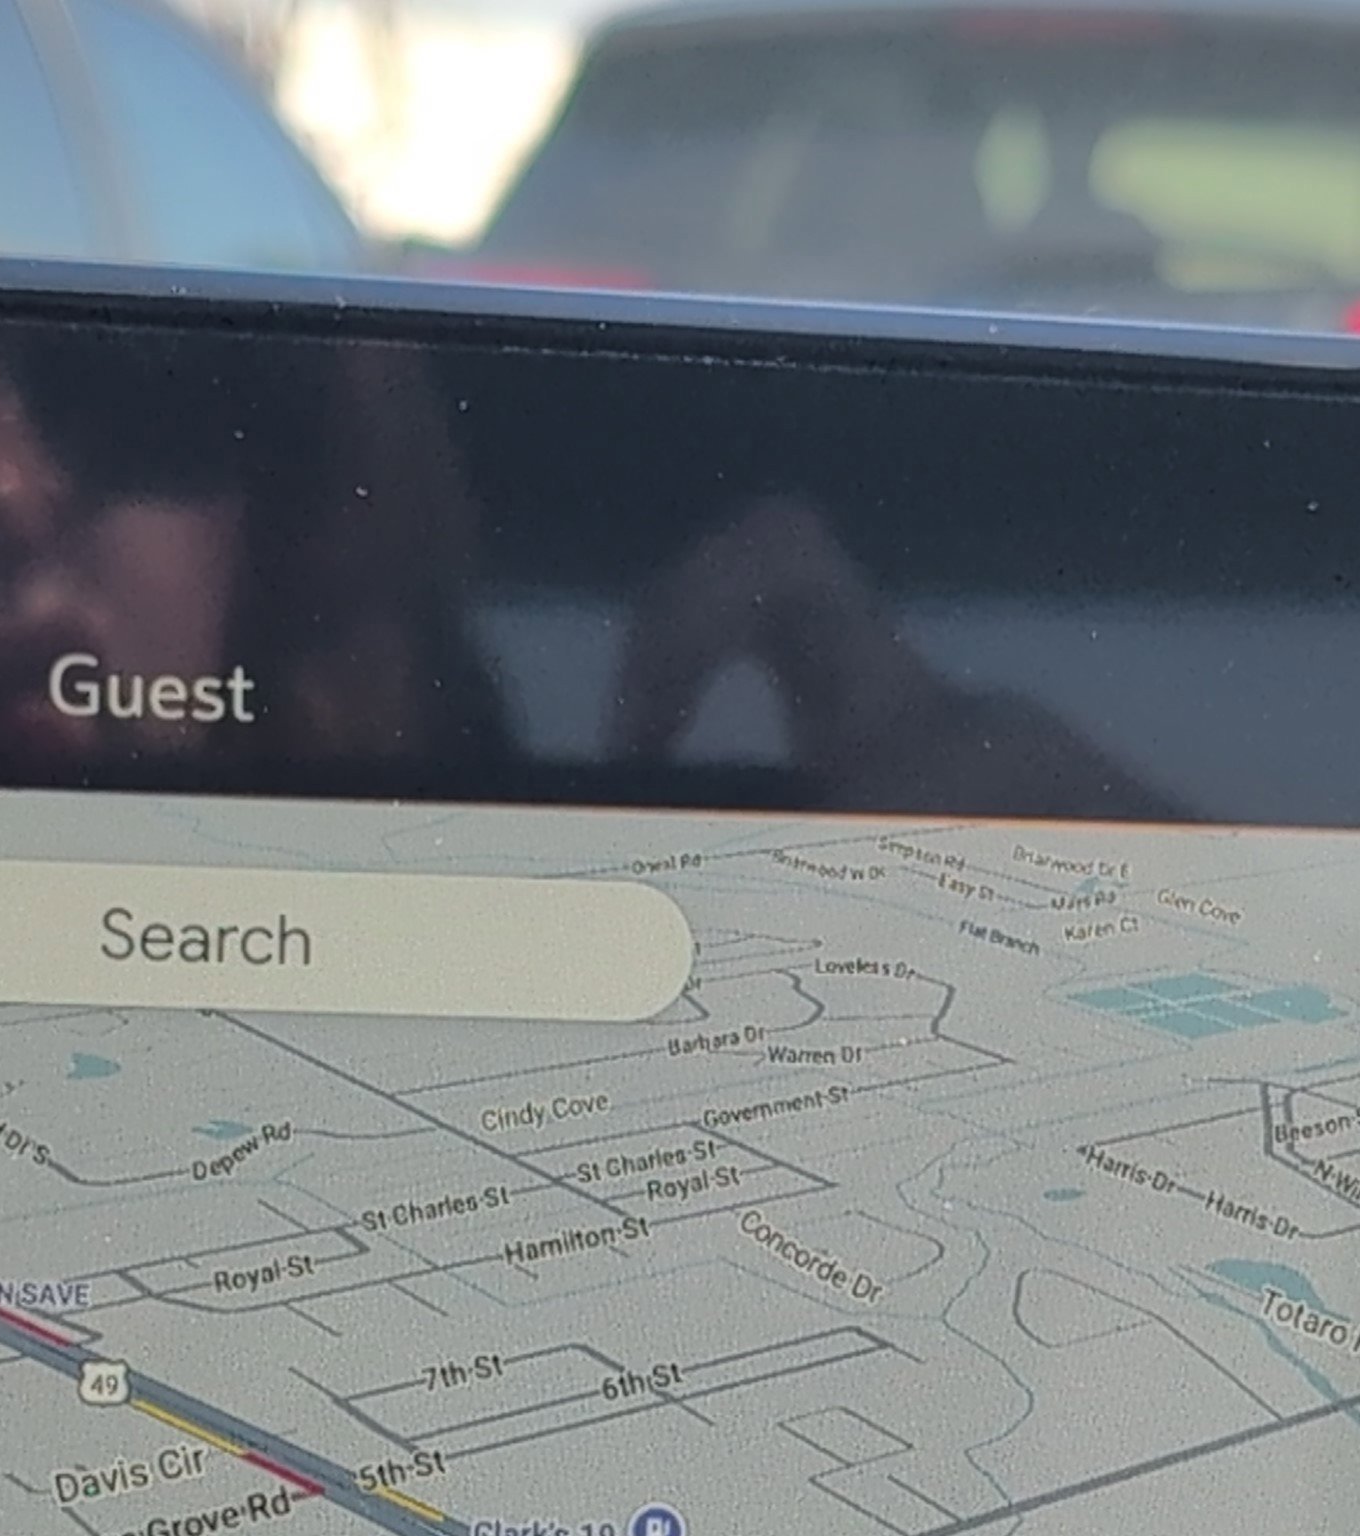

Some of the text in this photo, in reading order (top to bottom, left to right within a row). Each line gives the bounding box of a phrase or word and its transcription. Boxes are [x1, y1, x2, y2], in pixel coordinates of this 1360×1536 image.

[49, 653, 255, 722] Guest
[1198, 898, 1242, 925] Cove
[100, 906, 312, 966] Search
[958, 920, 1040, 955] Flat Branch
[1064, 923, 1115, 942] Karen
[767, 1045, 862, 1065] Warren Dr
[481, 1092, 610, 1132] Cindy Cove
[701, 1085, 849, 1128] Government St
[4, 1128, 35, 1156] Dr
[33, 1145, 51, 1167] S
[192, 1121, 292, 1182] Depew Rd
[576, 1138, 718, 1184] St Charles St
[647, 1164, 742, 1204] Royal St
[1085, 1146, 1179, 1195] Harris Dr
[1312, 1158, 1333, 1180] N
[361, 1186, 510, 1234] St Charles St
[1204, 1189, 1301, 1242] Harris Dr
[504, 1215, 651, 1266] Hamilton St
[739, 1209, 884, 1304] Concorde Dr
[213, 1252, 317, 1293] Royal St
[22, 1284, 90, 1307] SAVE
[1259, 1287, 1349, 1348] Totaro
[89, 1373, 120, 1397] 49
[421, 1354, 505, 1393] 7th St
[601, 1361, 684, 1402] 6th St
[54, 1445, 207, 1504] Davis Cir
[359, 1450, 448, 1493] 5th St
[246, 1485, 293, 1524] Rd
